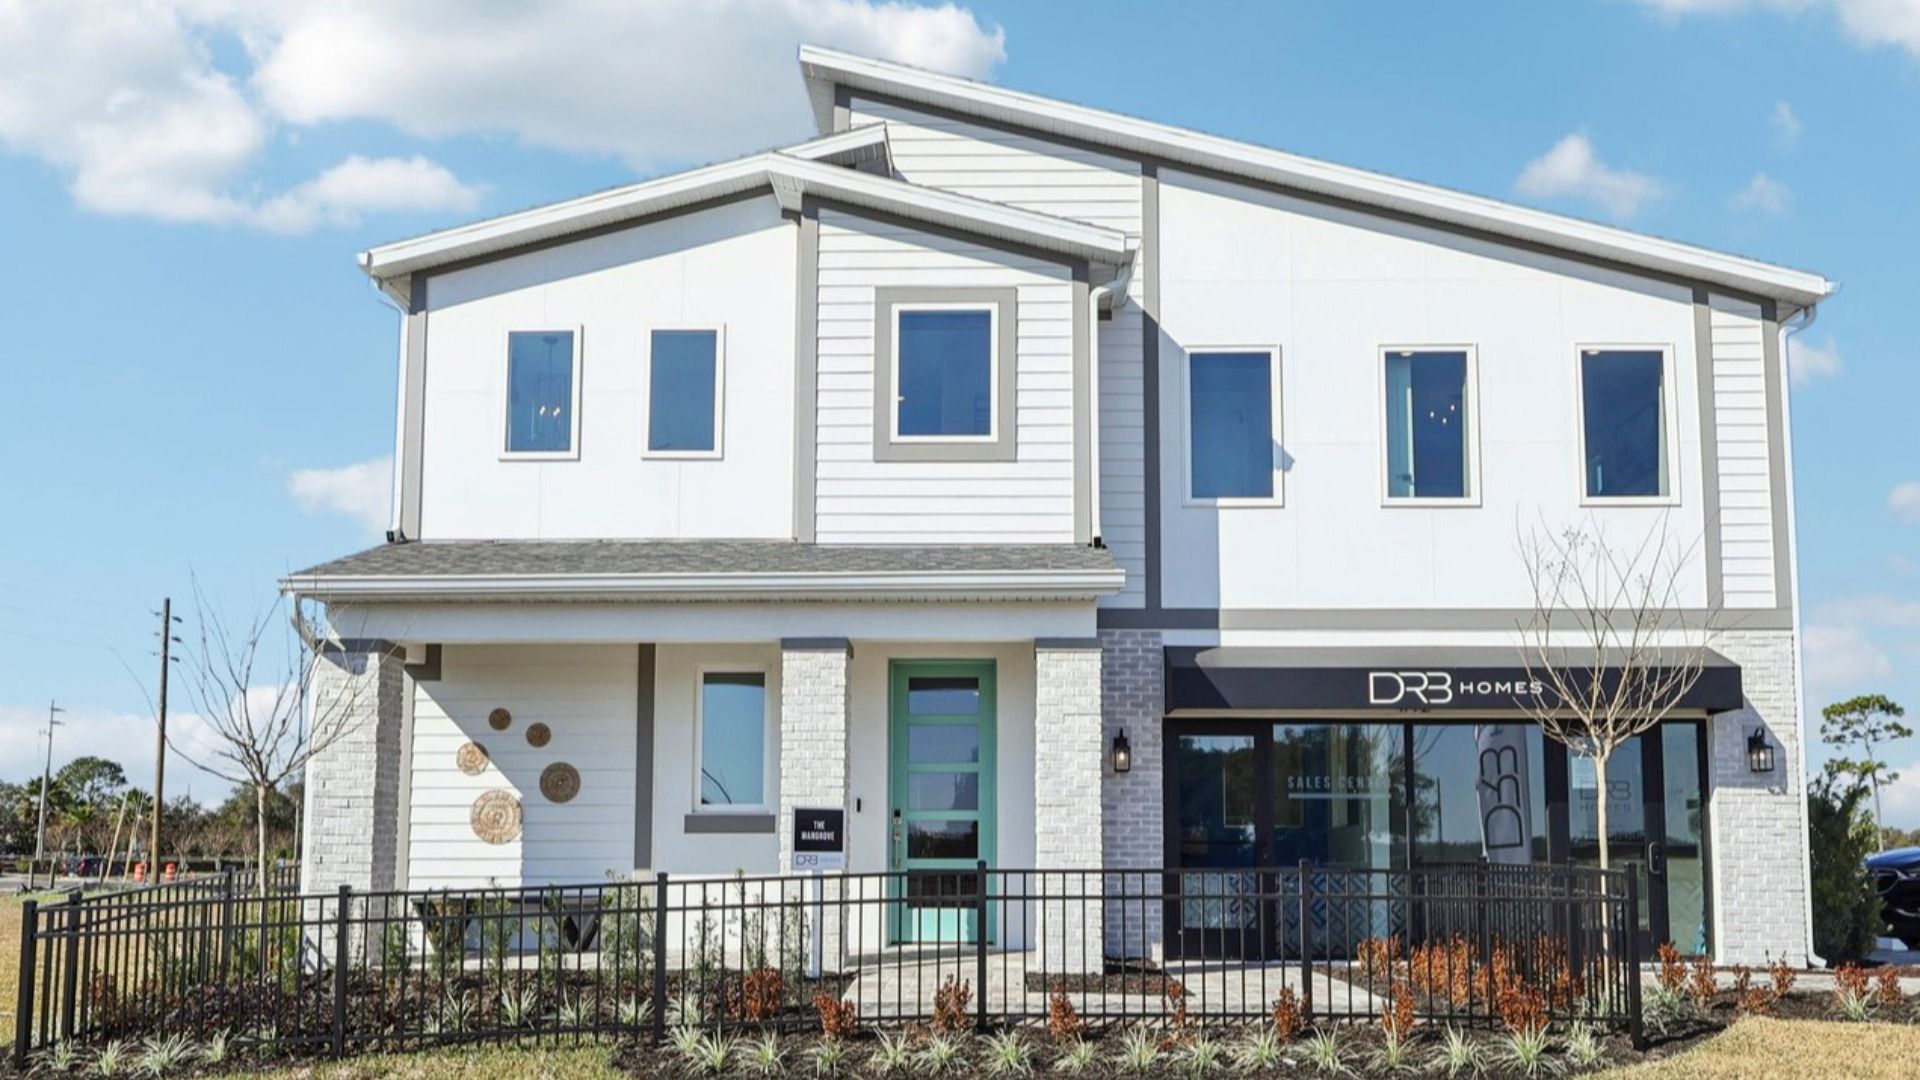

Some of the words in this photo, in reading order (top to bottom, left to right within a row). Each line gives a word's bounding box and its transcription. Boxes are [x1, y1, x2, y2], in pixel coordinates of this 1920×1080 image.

[1369, 671, 1453, 704] DRB
[1460, 681, 1543, 694] HOMES
[1287, 776, 1331, 789] SALES
[813, 820, 825, 830] THE
